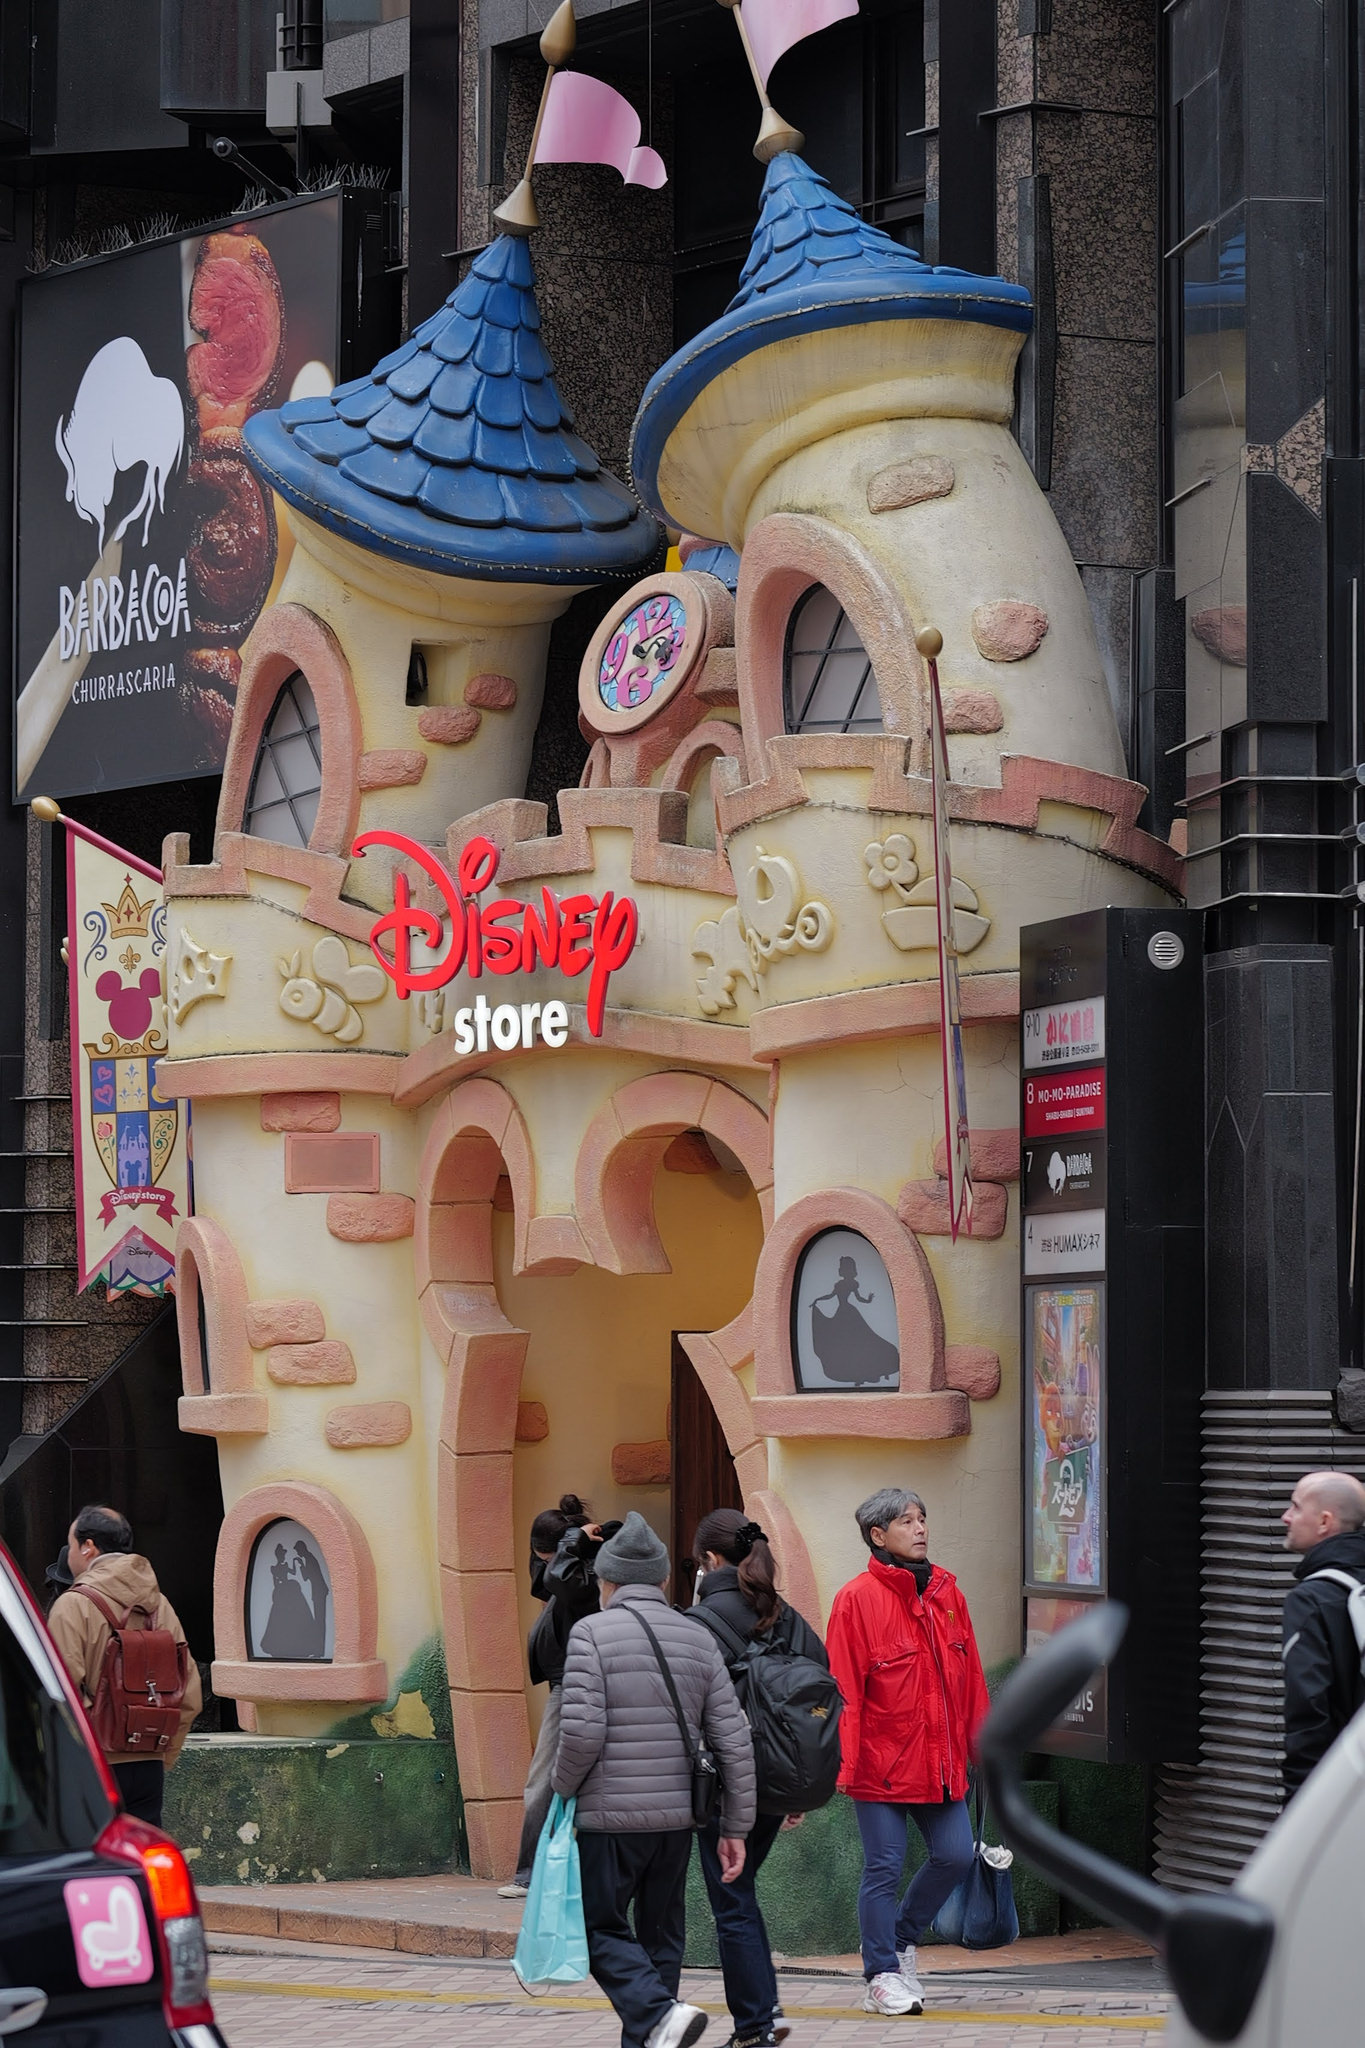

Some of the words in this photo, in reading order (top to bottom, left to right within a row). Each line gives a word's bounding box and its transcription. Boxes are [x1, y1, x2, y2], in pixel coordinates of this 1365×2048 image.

[59, 557, 191, 661] BARBACOA
[633, 596, 673, 645] 12
[601, 633, 628, 683] 9
[658, 627, 687, 671] 3
[72, 663, 176, 704] CHURRASCARIA
[616, 666, 653, 707] 6
[352, 830, 639, 1037] Disney
[454, 995, 569, 1055] store
[1026, 1082, 1034, 1105] 8
[1038, 1081, 1102, 1103] MO-MO-PARADISE
[1026, 1151, 1034, 1173] 7
[107, 1189, 141, 1205] Disney
[141, 1192, 166, 1202] store
[1027, 1220, 1034, 1245] 4
